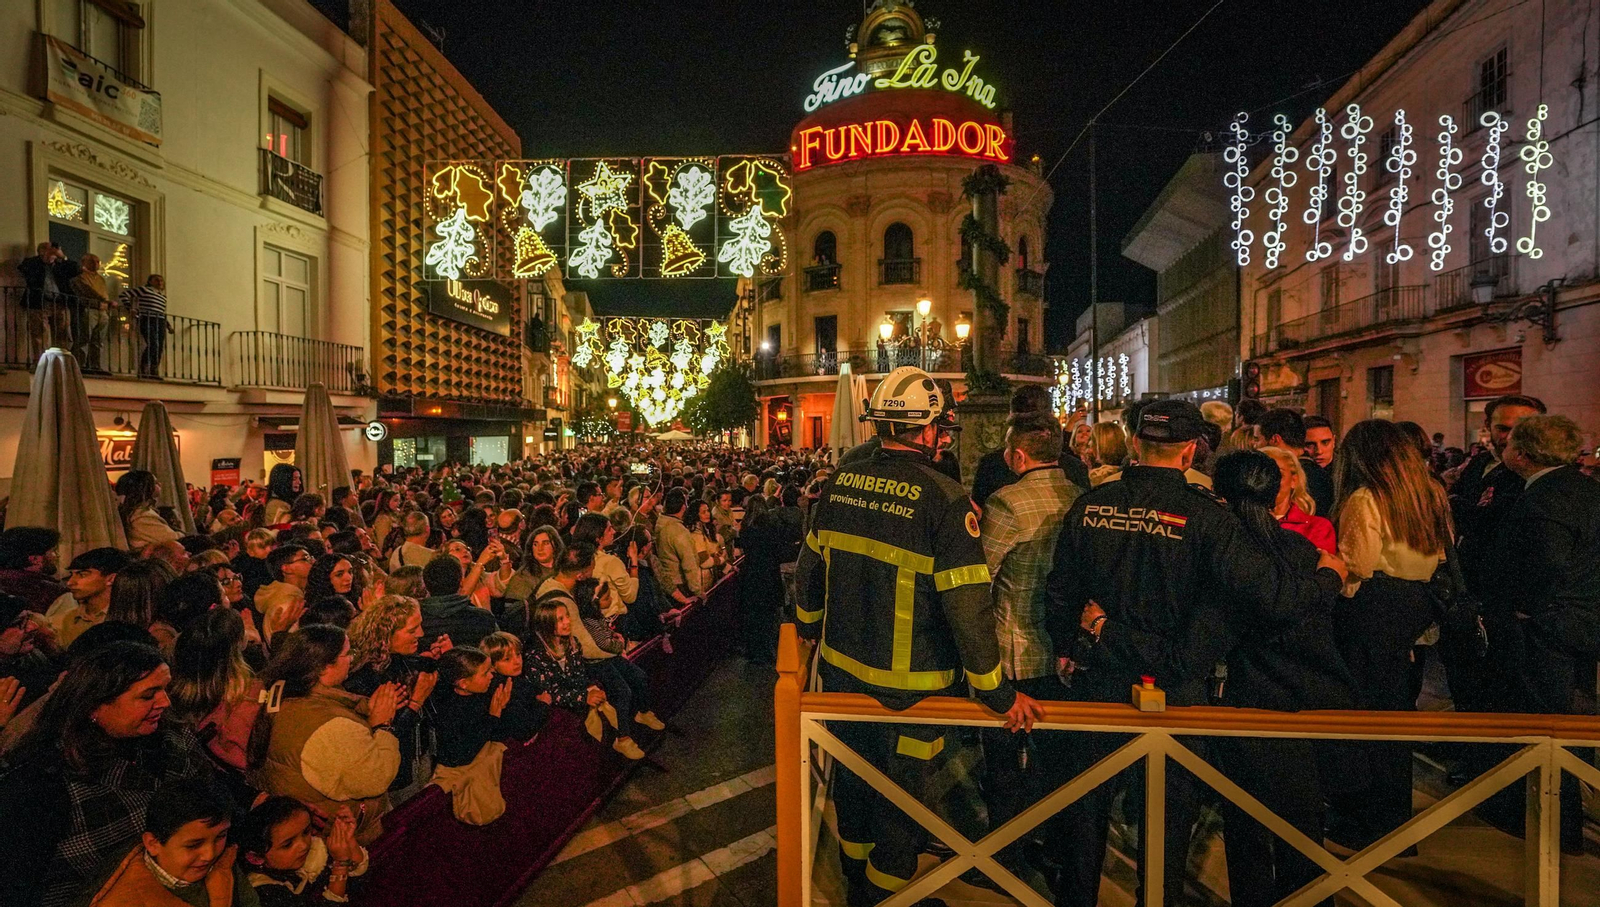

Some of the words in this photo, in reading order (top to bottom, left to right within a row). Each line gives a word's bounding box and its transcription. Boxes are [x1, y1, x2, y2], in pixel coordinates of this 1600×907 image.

[78, 72, 119, 99] aic
[804, 60, 872, 112] Fino
[874, 44, 938, 88] La
[941, 50, 996, 109] Ina
[799, 118, 1009, 169] FUNDADOR
[883, 399, 906, 408] 7290
[99, 437, 133, 465] Mal
[835, 472, 923, 501] BOMBEROS
[829, 493, 868, 509] provincia
[869, 500, 880, 511] de
[882, 501, 915, 519] CÁDIZ
[1083, 516, 1183, 540] NACIONAL
